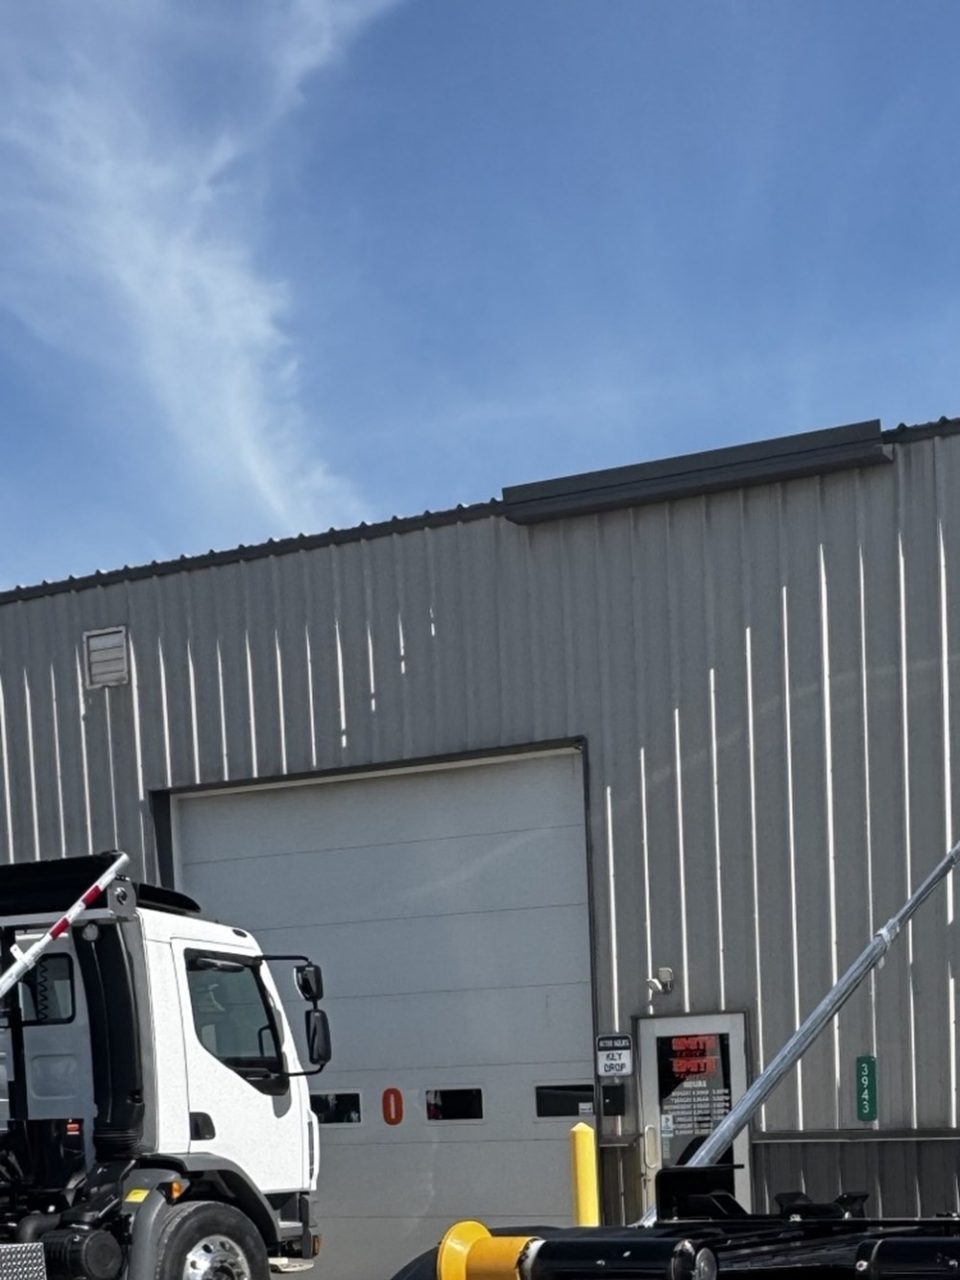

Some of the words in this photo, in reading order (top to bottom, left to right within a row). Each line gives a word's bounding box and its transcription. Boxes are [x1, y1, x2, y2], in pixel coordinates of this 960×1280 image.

[606, 1052, 623, 1062] KEY
[604, 1063, 626, 1073] DROP
[861, 1063, 869, 1113] 3943
